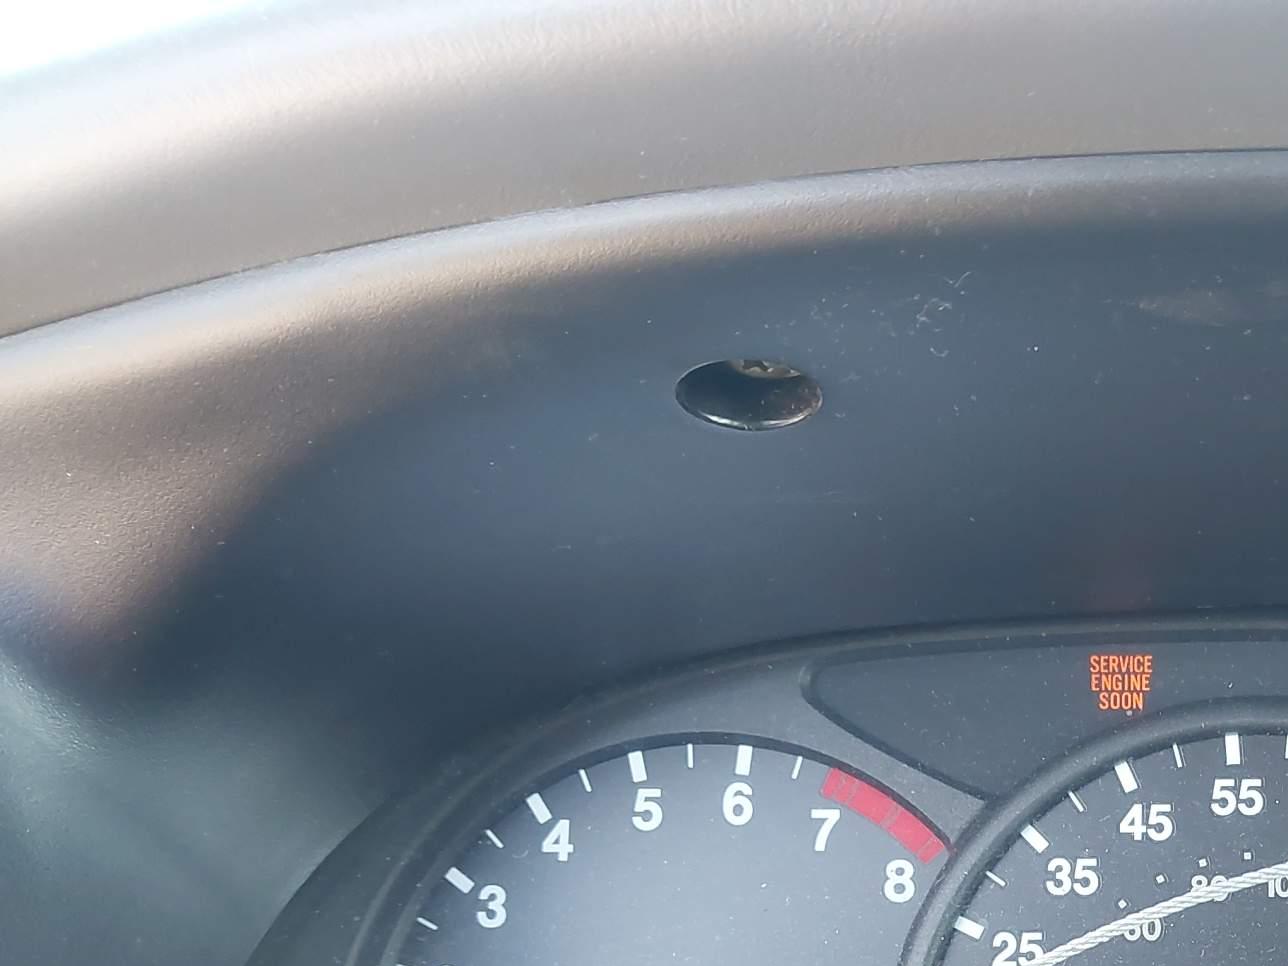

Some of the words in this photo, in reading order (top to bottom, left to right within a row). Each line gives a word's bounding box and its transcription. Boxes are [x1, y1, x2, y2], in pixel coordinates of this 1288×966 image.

[1089, 655, 1153, 673] SERVICE
[1090, 673, 1151, 691] ENGINE
[1098, 691, 1143, 710] SOON
[631, 788, 663, 831] 5
[722, 782, 753, 825] 6
[1210, 778, 1264, 816] 55
[541, 819, 574, 861] 4
[811, 809, 841, 851] 7
[1119, 803, 1174, 841] 45
[884, 860, 915, 903] 8
[1045, 857, 1099, 896] 35
[476, 885, 507, 928] 3
